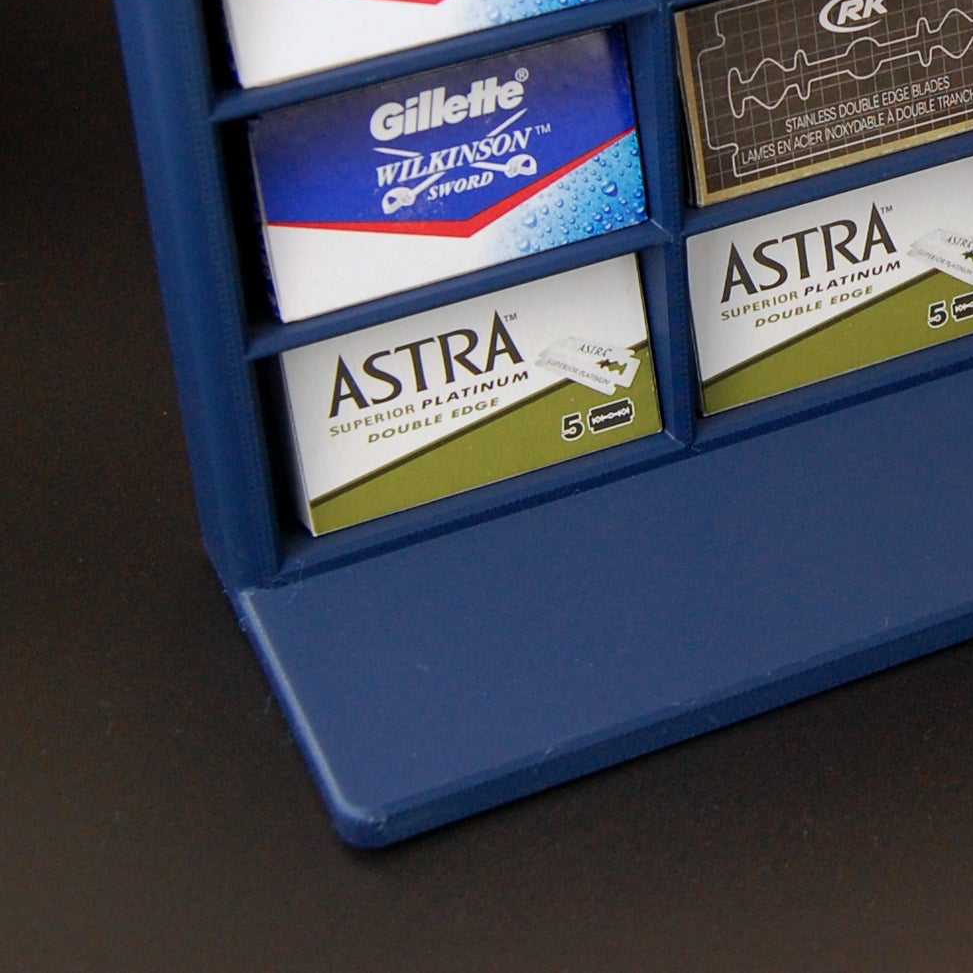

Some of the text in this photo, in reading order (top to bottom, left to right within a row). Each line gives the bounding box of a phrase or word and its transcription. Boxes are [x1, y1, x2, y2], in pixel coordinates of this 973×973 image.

[370, 76, 524, 142] Gillette
[741, 145, 776, 165] LAMES
[777, 140, 791, 153] EN
[793, 129, 823, 150] ACIER
[825, 114, 884, 141] INOXYDABLE
[897, 102, 935, 122] DOUBLE
[785, 76, 950, 133] STAINLESS DOUBLE EDGE BLADES
[376, 127, 532, 188] WILKINSON
[428, 171, 494, 201] SWORD
[720, 202, 898, 303] ASTRA
[721, 260, 901, 321] SUPERIOR PLATINUM
[755, 285, 874, 328] DOUBLE EDGE
[929, 302, 947, 326] 5
[328, 310, 525, 418] ASTRA
[330, 371, 529, 436] SUPERIOR PLATINUM
[368, 397, 500, 443] DOUBLE EDGE
[562, 414, 584, 440] 5
